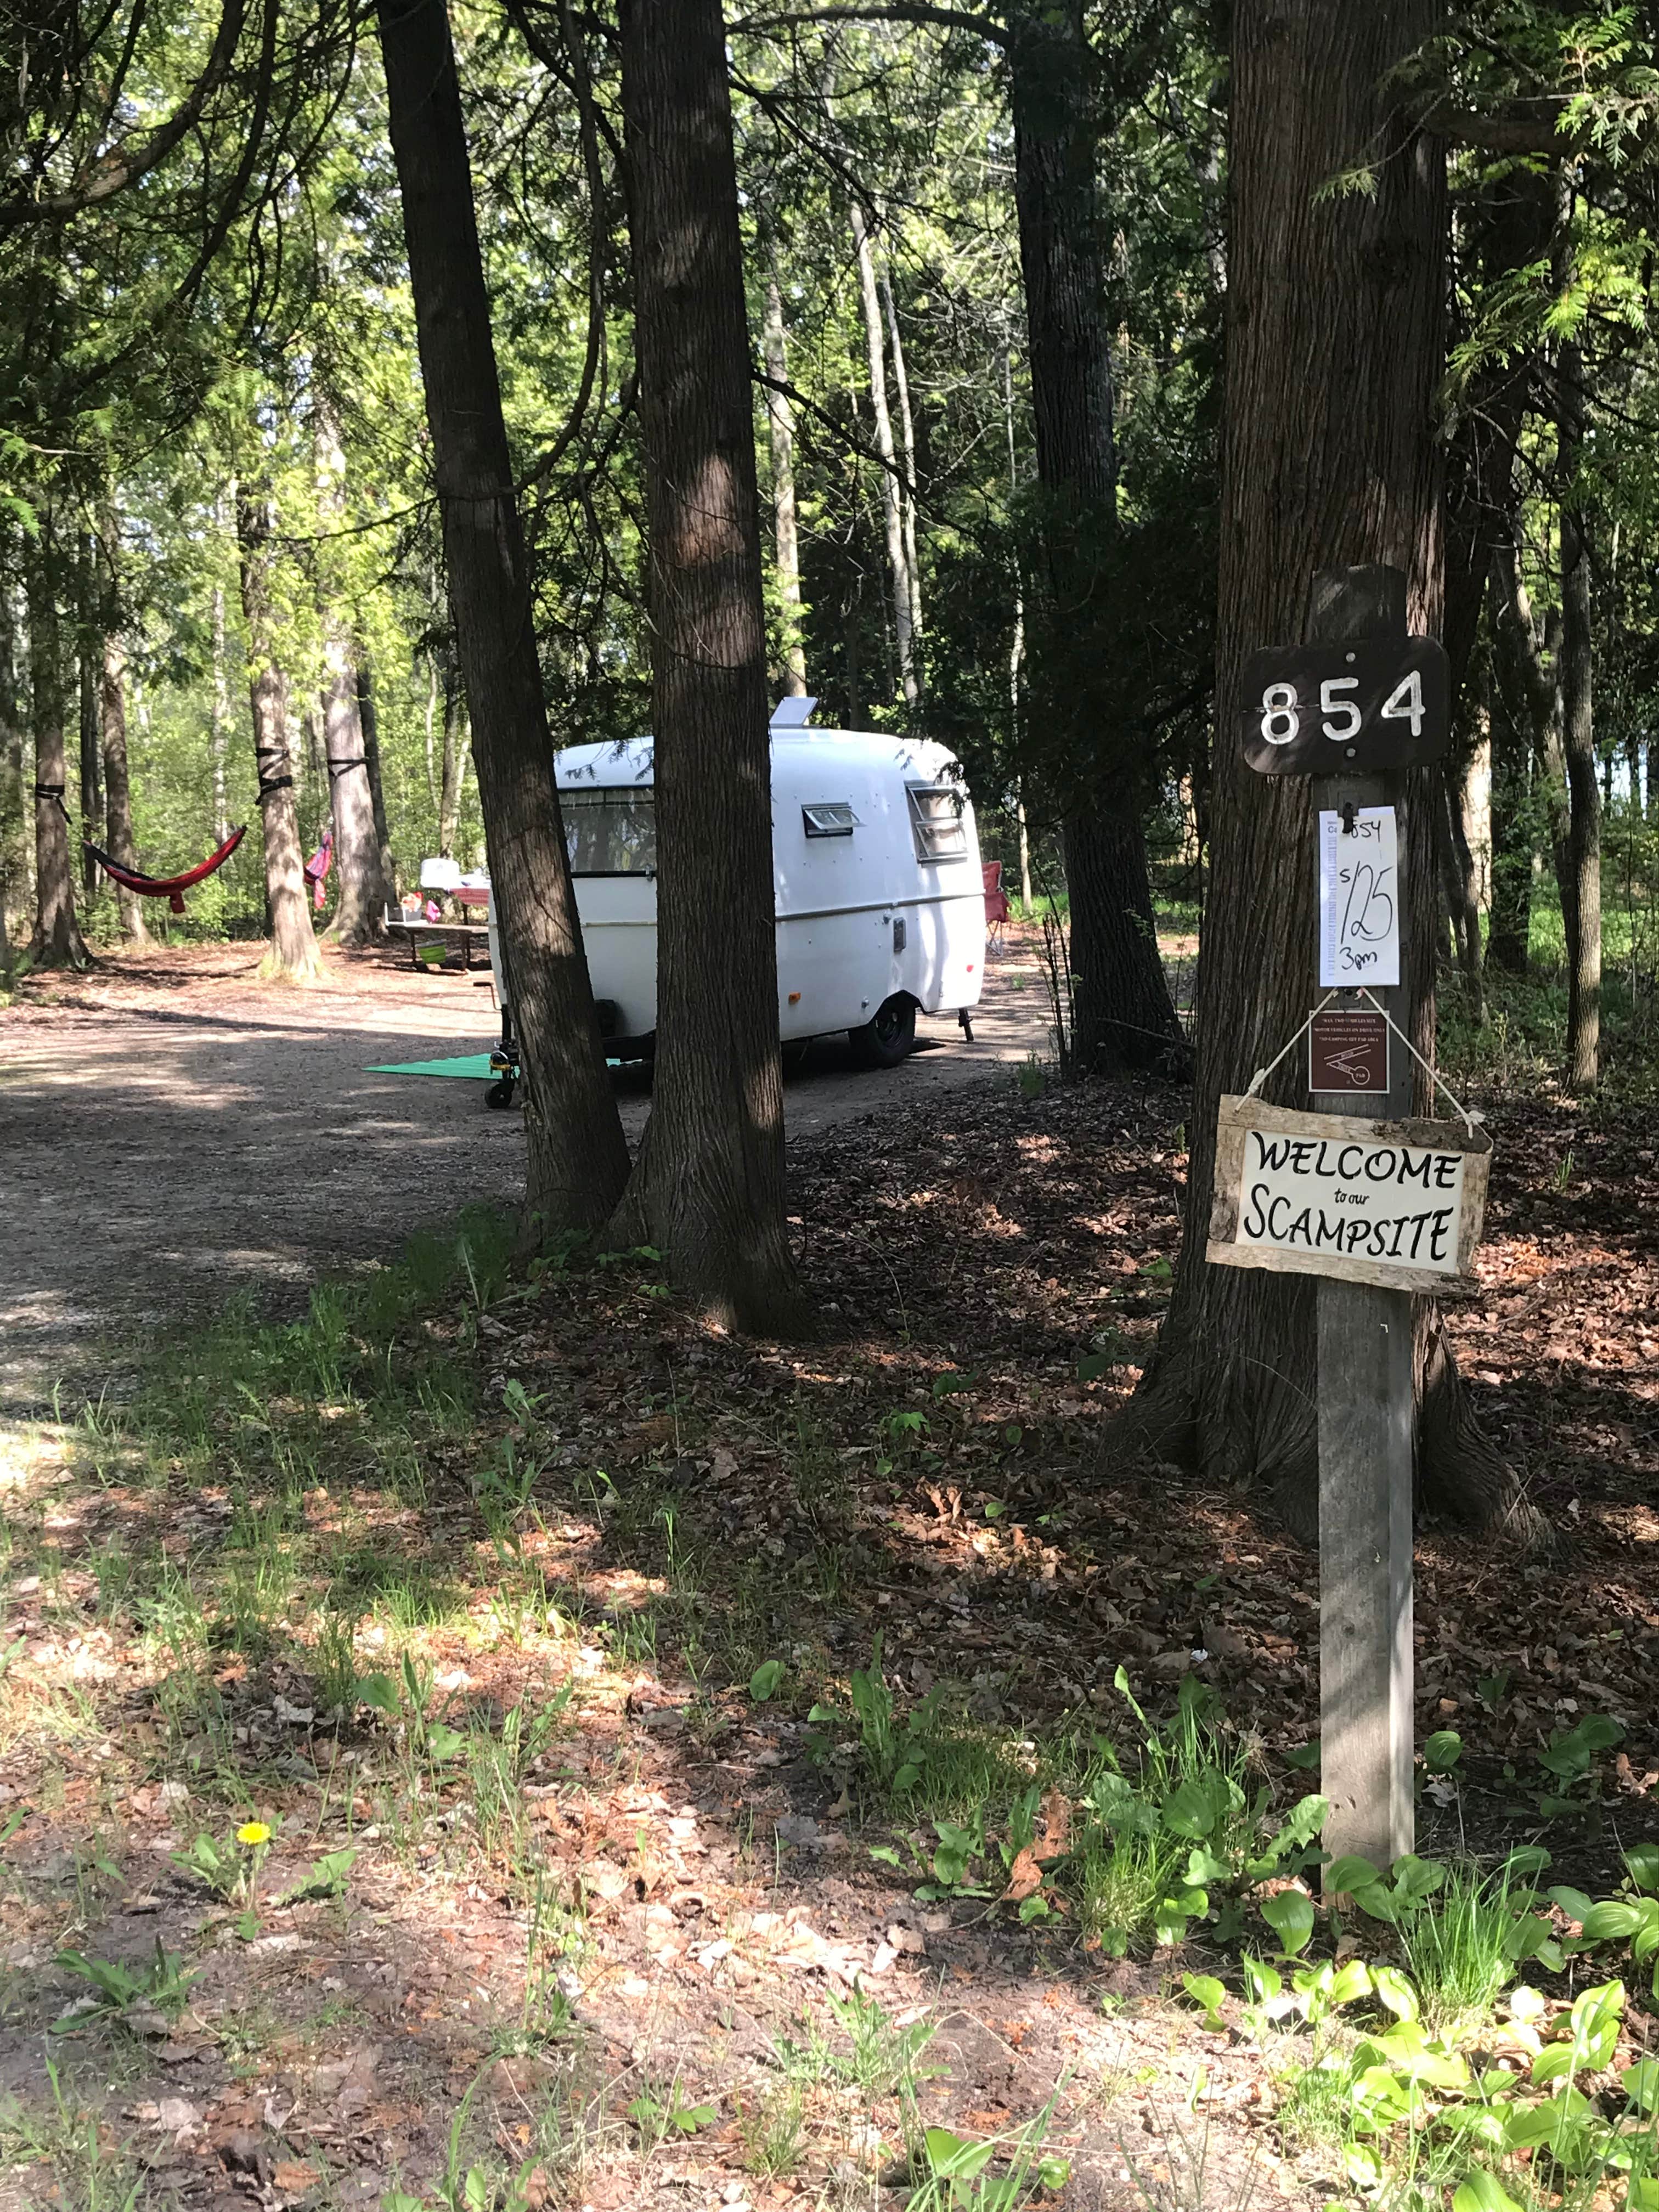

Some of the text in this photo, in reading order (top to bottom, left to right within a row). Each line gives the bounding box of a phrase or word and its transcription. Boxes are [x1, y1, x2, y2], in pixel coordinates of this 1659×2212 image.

[1261, 670, 1426, 744] 854
[1251, 1131, 1462, 1188] WELCOME
[1244, 1183, 1453, 1261] SCAMPSITE
[1334, 1188, 1370, 1205] to our
